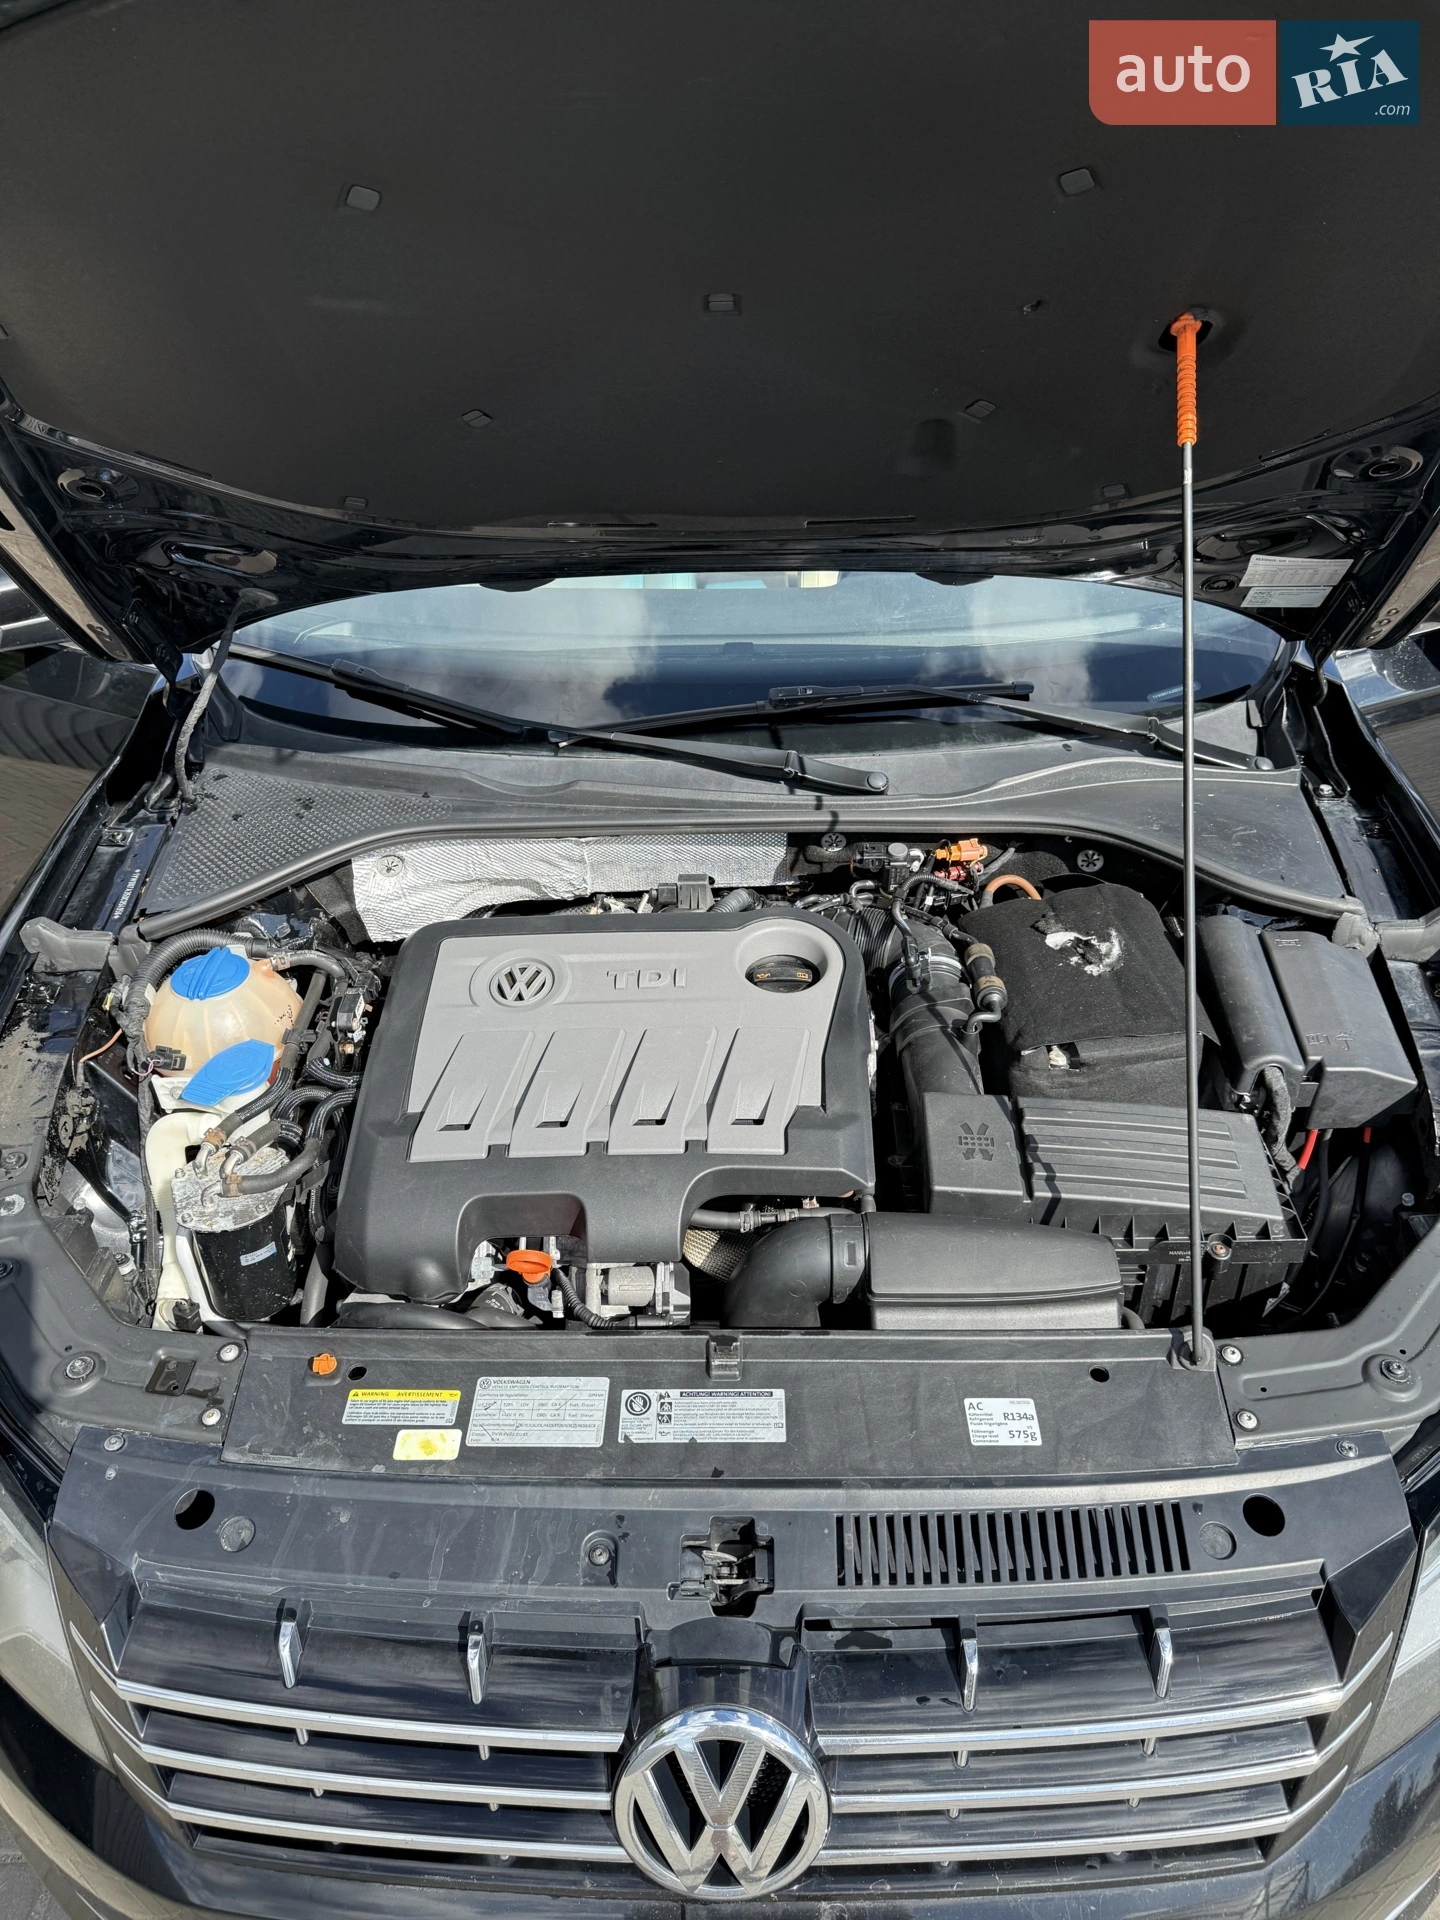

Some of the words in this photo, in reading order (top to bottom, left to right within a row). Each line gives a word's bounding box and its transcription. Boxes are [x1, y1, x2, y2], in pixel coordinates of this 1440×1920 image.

[607, 967, 687, 990] TDI
[968, 1402, 983, 1410] AC
[1003, 1412, 1034, 1421] R134a
[1008, 1430, 1038, 1441] 575g
[616, 1713, 828, 1901] VW
